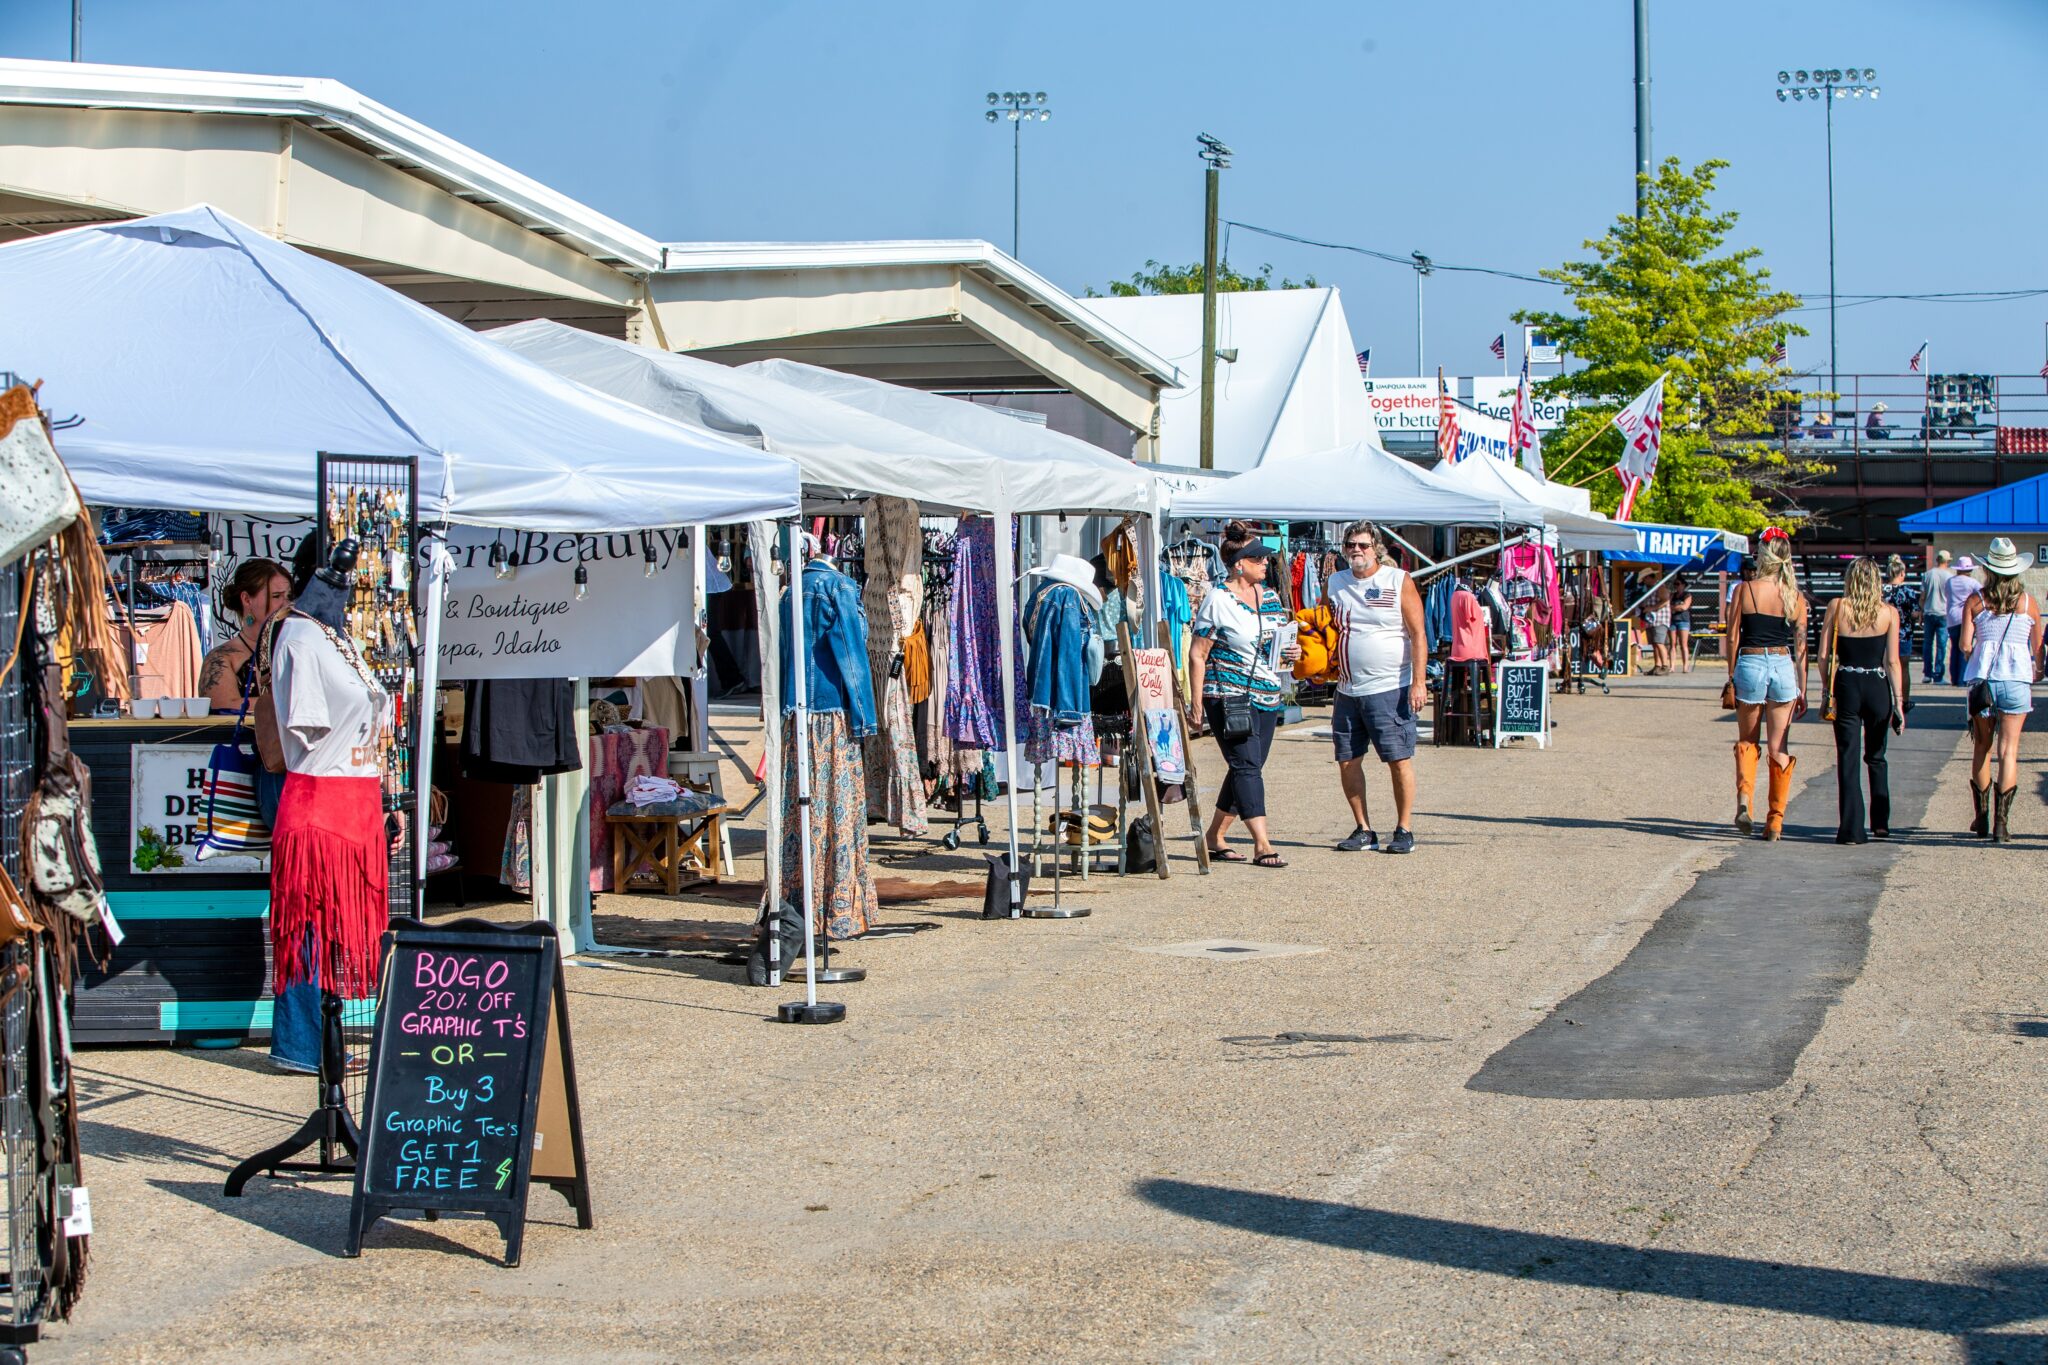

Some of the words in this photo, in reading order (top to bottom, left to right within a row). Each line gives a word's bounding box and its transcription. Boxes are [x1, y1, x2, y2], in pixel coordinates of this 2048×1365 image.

[1368, 394, 1439, 413] ogether
[1374, 412, 1397, 428] for
[1400, 412, 1440, 428] bette
[222, 518, 318, 567] Hig
[446, 600, 459, 619] &
[466, 594, 570, 625] Boutique
[492, 629, 562, 656] Idaho
[1507, 668, 1537, 684] SALE
[1507, 684, 1526, 699] BUY
[1525, 684, 1534, 699] 1
[1505, 697, 1524, 711] GET
[1523, 698, 1533, 711] 1
[1523, 709, 1540, 720] OFF
[415, 953, 509, 989] BOGO
[418, 990, 468, 1010] 20%
[477, 992, 515, 1012] OFF
[401, 1012, 483, 1036] GRAPHIC
[431, 1043, 475, 1065] OR
[424, 1075, 469, 1112] Buy
[474, 1075, 495, 1102] 3
[385, 1111, 464, 1135] Graphic
[475, 1116, 520, 1137] Tee's
[400, 1139, 460, 1164] GET
[462, 1139, 482, 1163] 1
[395, 1165, 479, 1190] FREE
